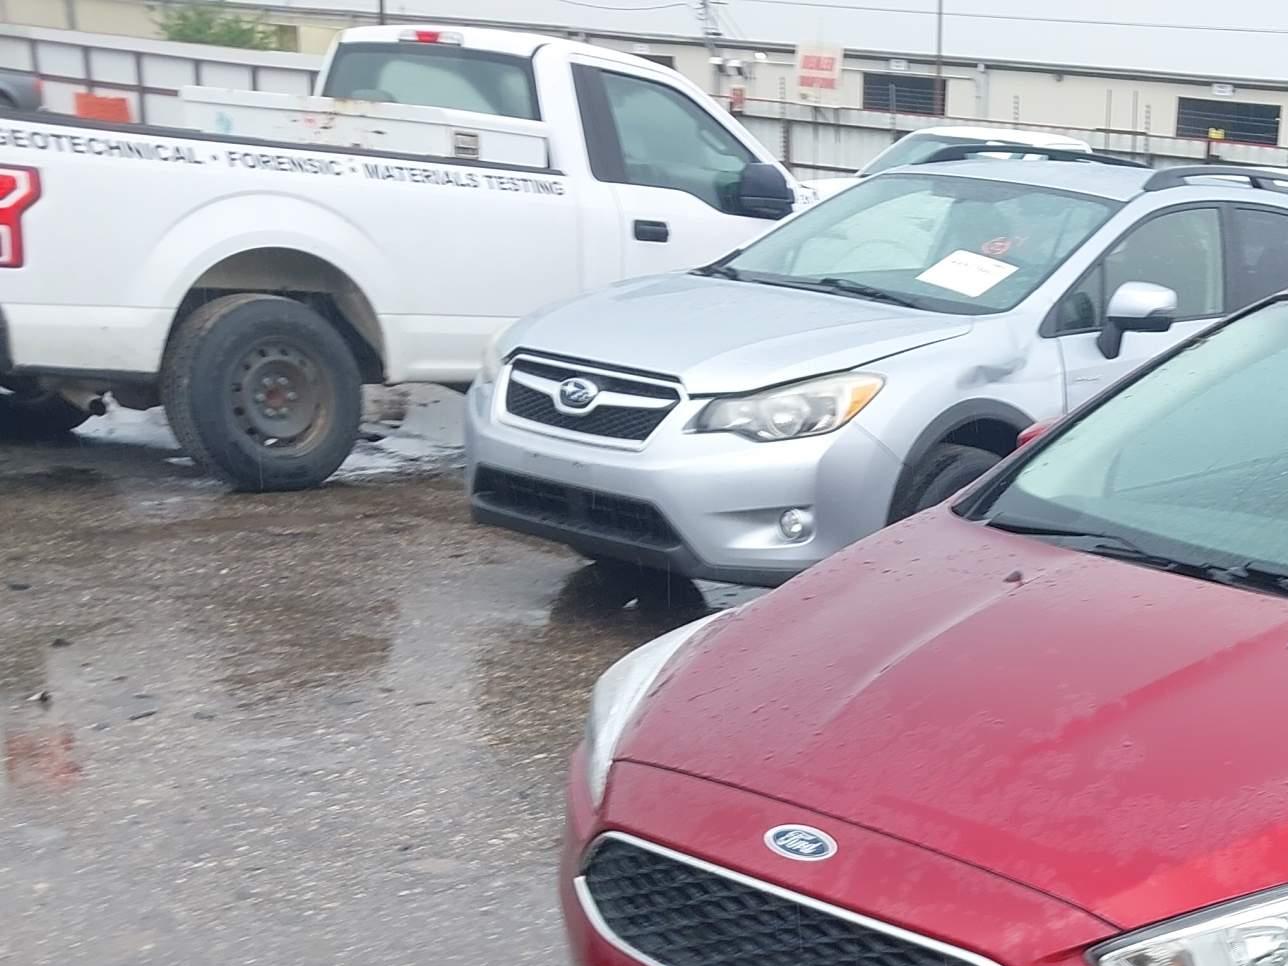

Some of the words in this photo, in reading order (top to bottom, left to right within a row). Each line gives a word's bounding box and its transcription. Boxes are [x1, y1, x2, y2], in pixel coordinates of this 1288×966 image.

[223, 149, 343, 176] FORENSIC
[363, 162, 481, 189] MATERIALS
[483, 174, 566, 197] TESTING
[775, 829, 824, 855] Ford
